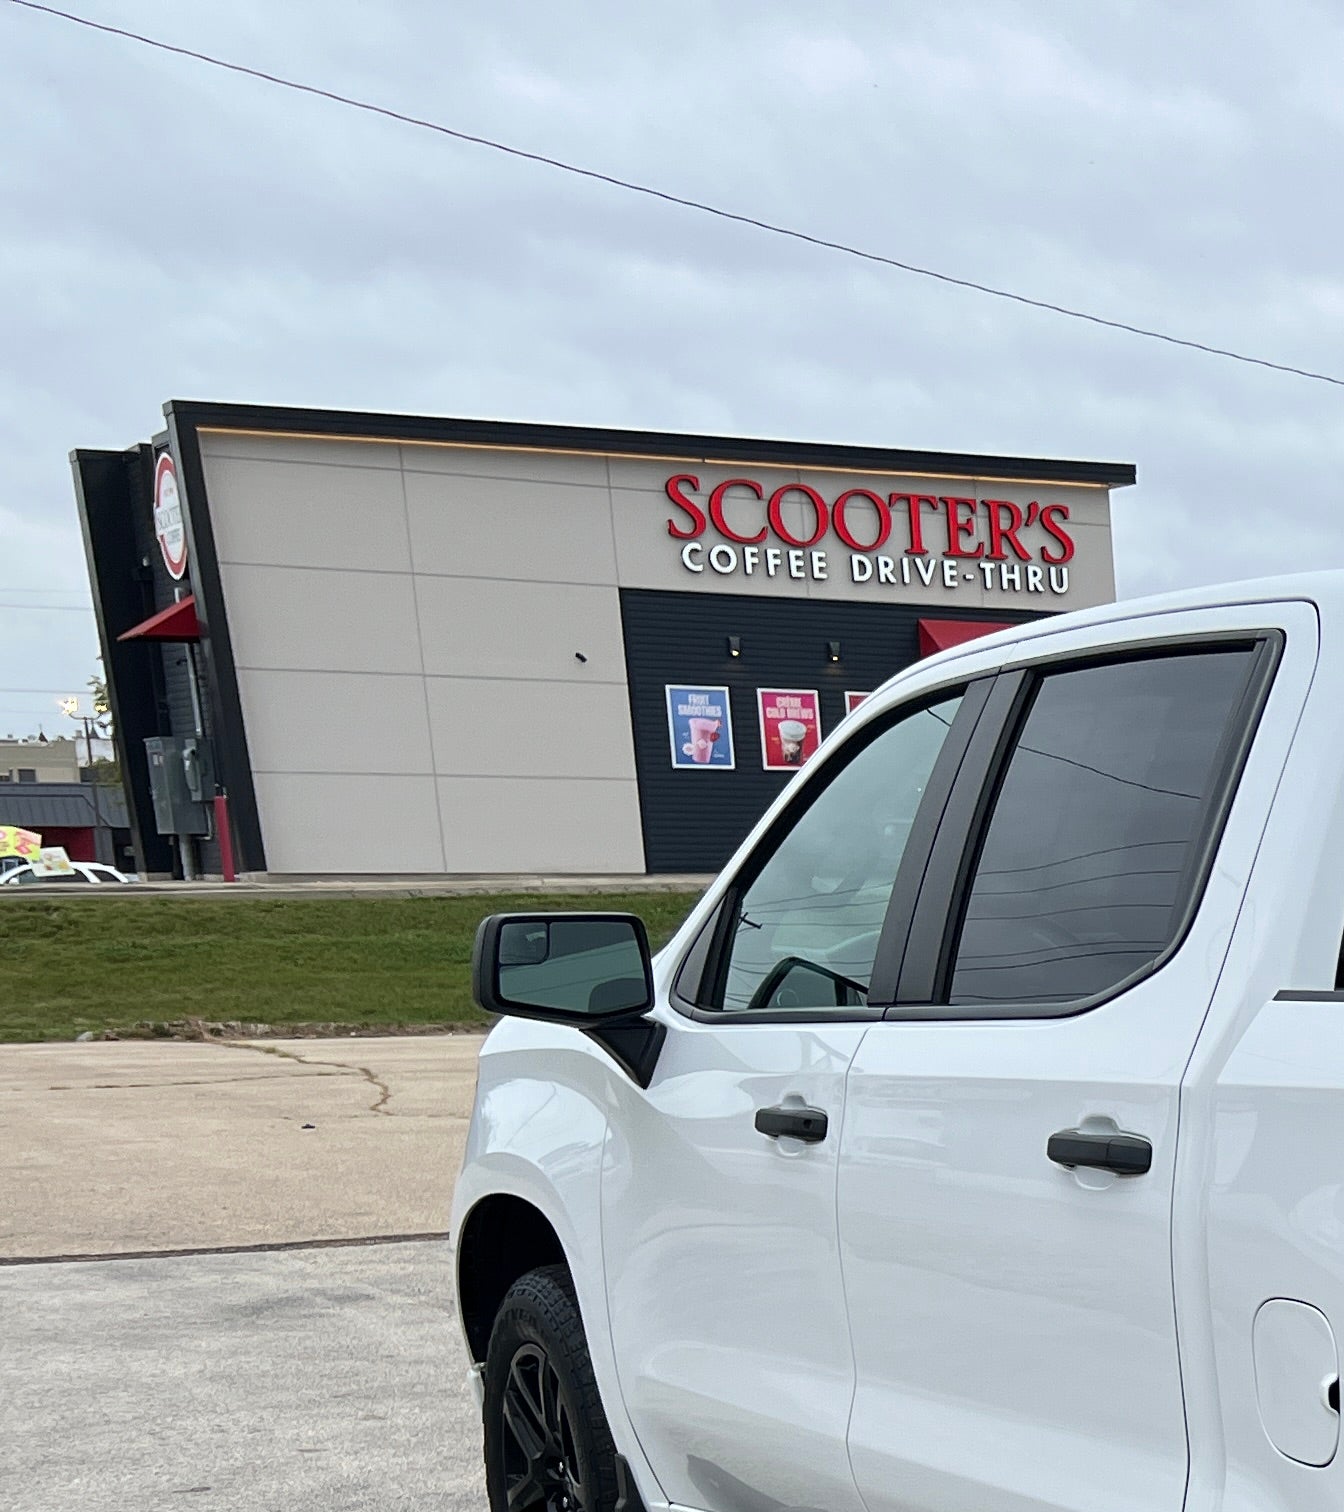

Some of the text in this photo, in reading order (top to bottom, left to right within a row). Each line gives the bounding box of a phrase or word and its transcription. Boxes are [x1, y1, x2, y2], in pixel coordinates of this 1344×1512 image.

[665, 474, 1075, 564] SCOOTER'S
[680, 542, 1070, 595] COFFEE DRIVE-THRU
